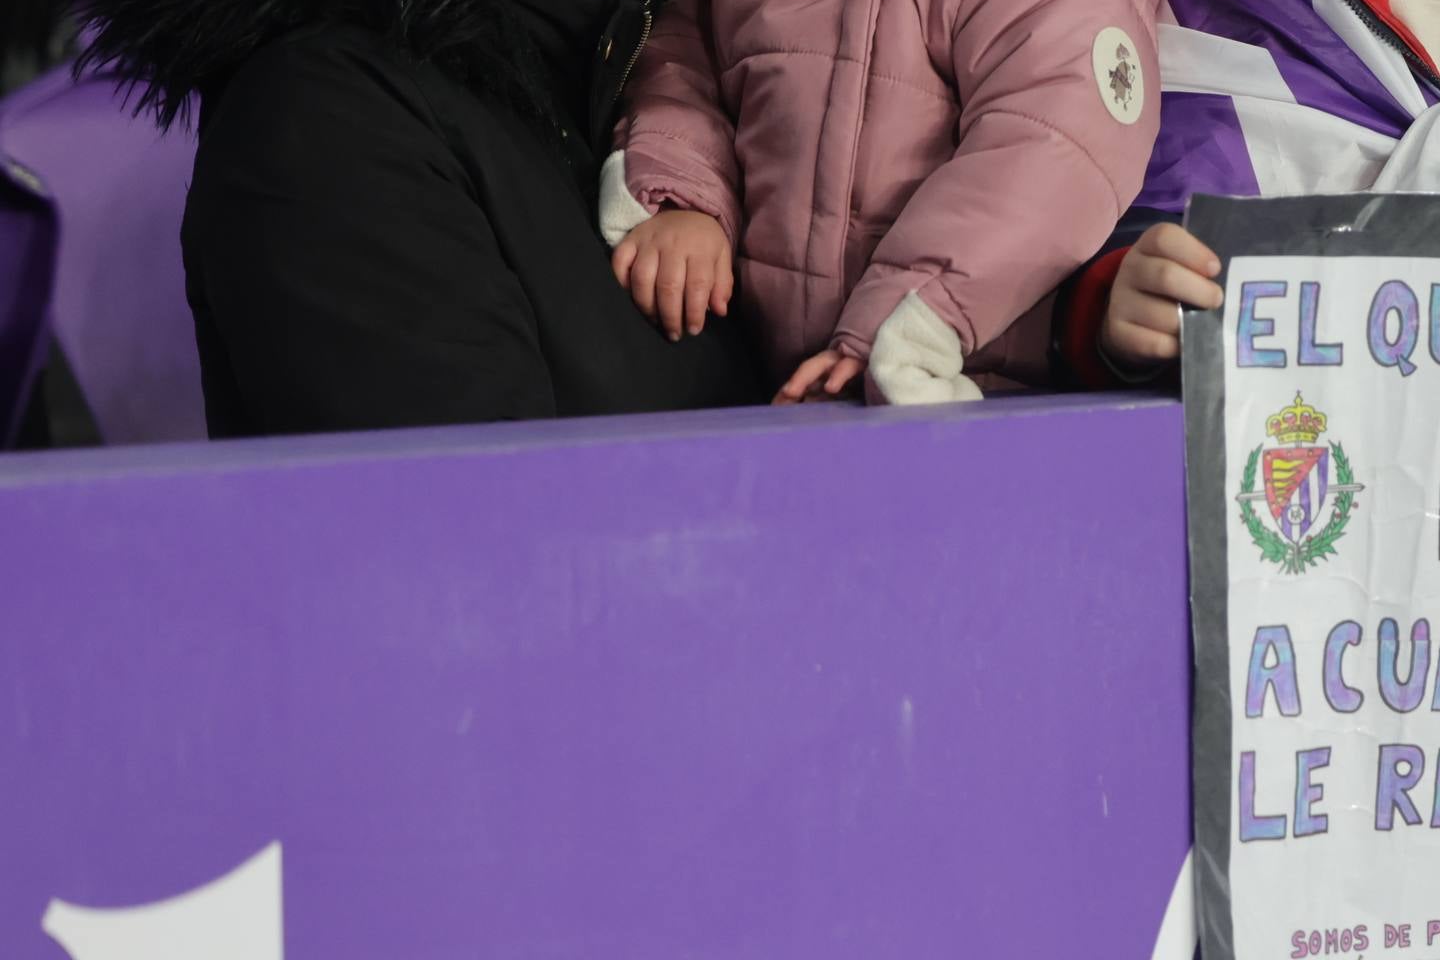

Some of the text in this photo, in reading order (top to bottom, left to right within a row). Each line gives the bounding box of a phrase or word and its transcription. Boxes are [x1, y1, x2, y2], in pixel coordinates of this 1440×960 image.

[1236, 280, 1343, 368] EL
[1245, 624, 1302, 719] A
[1238, 746, 1332, 843] LE
[1290, 924, 1370, 959] SOMOS
[1383, 923, 1412, 949] DE
